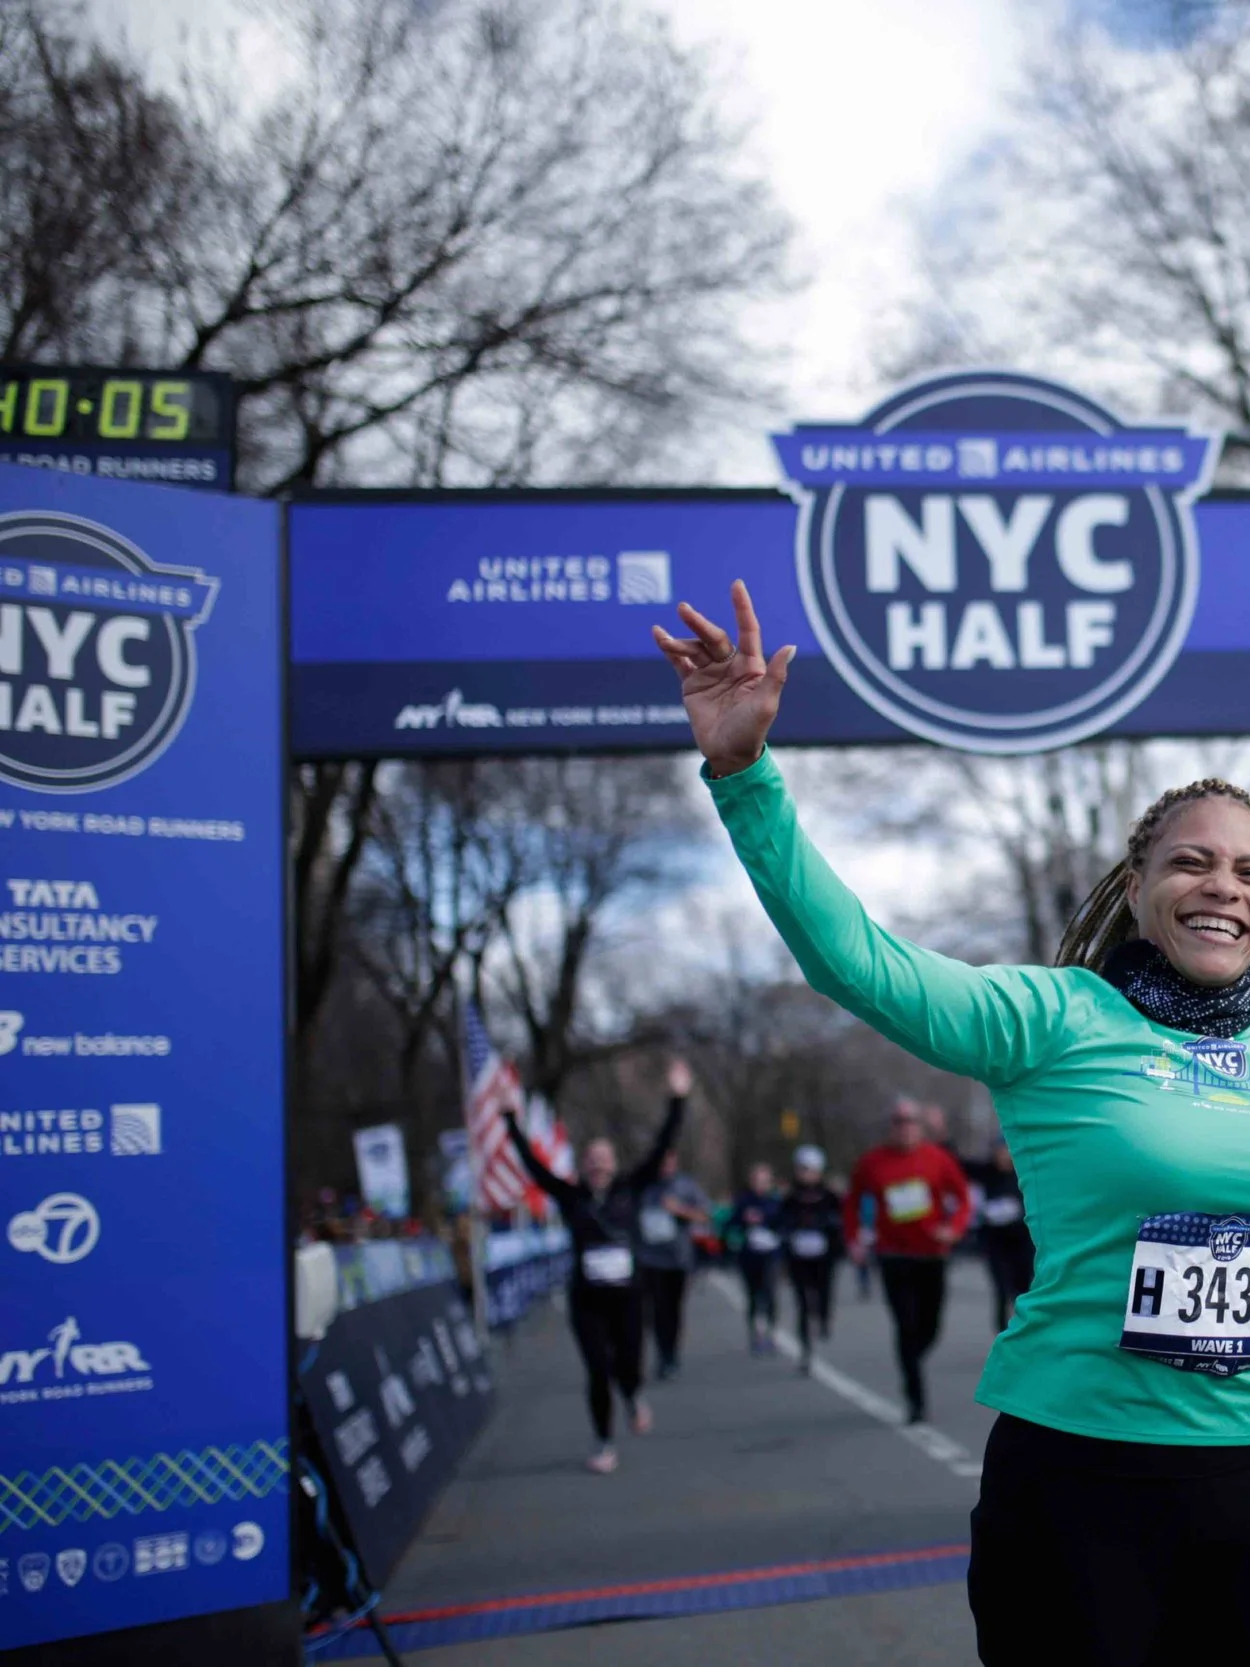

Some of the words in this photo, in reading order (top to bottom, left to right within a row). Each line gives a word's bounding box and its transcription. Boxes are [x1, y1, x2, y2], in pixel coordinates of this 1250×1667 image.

[97, 455, 217, 482] RUNNERS
[802, 444, 953, 471] UNITED
[1004, 444, 1185, 474] AIRLINES
[864, 493, 1134, 593] NYC
[479, 555, 611, 581] UNITED
[61, 575, 192, 609] AIRLINES
[447, 579, 611, 603] AIRLINES
[887, 601, 1118, 671] HALF
[0, 682, 136, 740] ALF
[20, 810, 80, 833] YORK
[83, 813, 145, 837] ROAD
[148, 816, 245, 841] RUNNERS
[7, 878, 100, 909] TATA
[0, 912, 157, 942] NSULTANCY
[0, 944, 122, 974] ERVICES
[23, 1036, 72, 1056] new
[75, 1033, 171, 1057] balance
[1196, 1052, 1239, 1068] NYC
[0, 1109, 103, 1132] NITED
[0, 1131, 103, 1155] LINES
[1215, 1232, 1243, 1245] NYC
[1132, 1268, 1165, 1316] H
[1191, 1339, 1233, 1353] WAVE
[1236, 1339, 1243, 1353] 1
